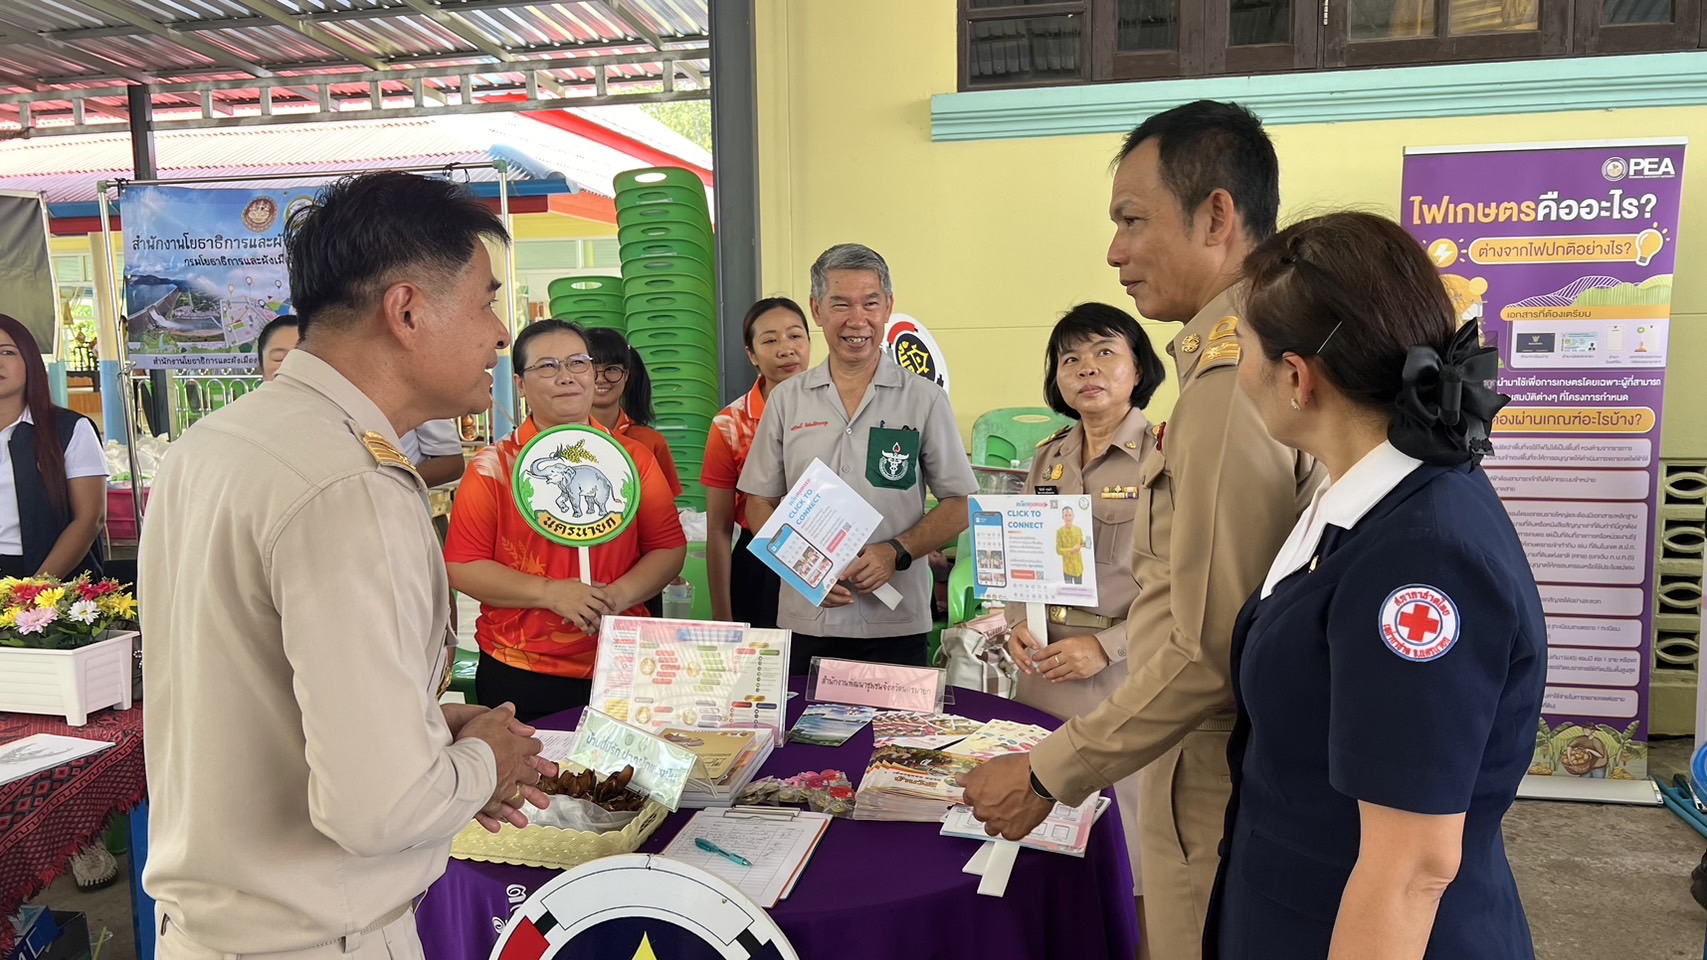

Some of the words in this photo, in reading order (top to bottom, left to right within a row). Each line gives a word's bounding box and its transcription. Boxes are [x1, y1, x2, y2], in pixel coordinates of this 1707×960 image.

[1629, 158, 1675, 176] PEA
[1409, 189, 1657, 225] ไฟเกษตรคืออะไร?
[132, 232, 285, 251] สำนักงานโยธาธิการและผั
[1479, 240, 1632, 258] ต่างจากไฟปกติอย่างไร?
[184, 253, 287, 267] กรมโยธาธิการและผังเมื
[1507, 309, 1592, 319] เอกสารที่ต้องเตรียม
[1559, 389, 1629, 402] ที่โครงการกำหนด
[788, 499, 805, 519] CLICK
[803, 489, 813, 499] TO
[796, 493, 821, 525] CONNECT
[1007, 510, 1029, 518] CLICK
[1030, 510, 1042, 518] TO
[543, 516, 616, 538] นครนายก
[1007, 521, 1044, 530] CONNECT
[1393, 591, 1451, 617] สภากาชาดไทย
